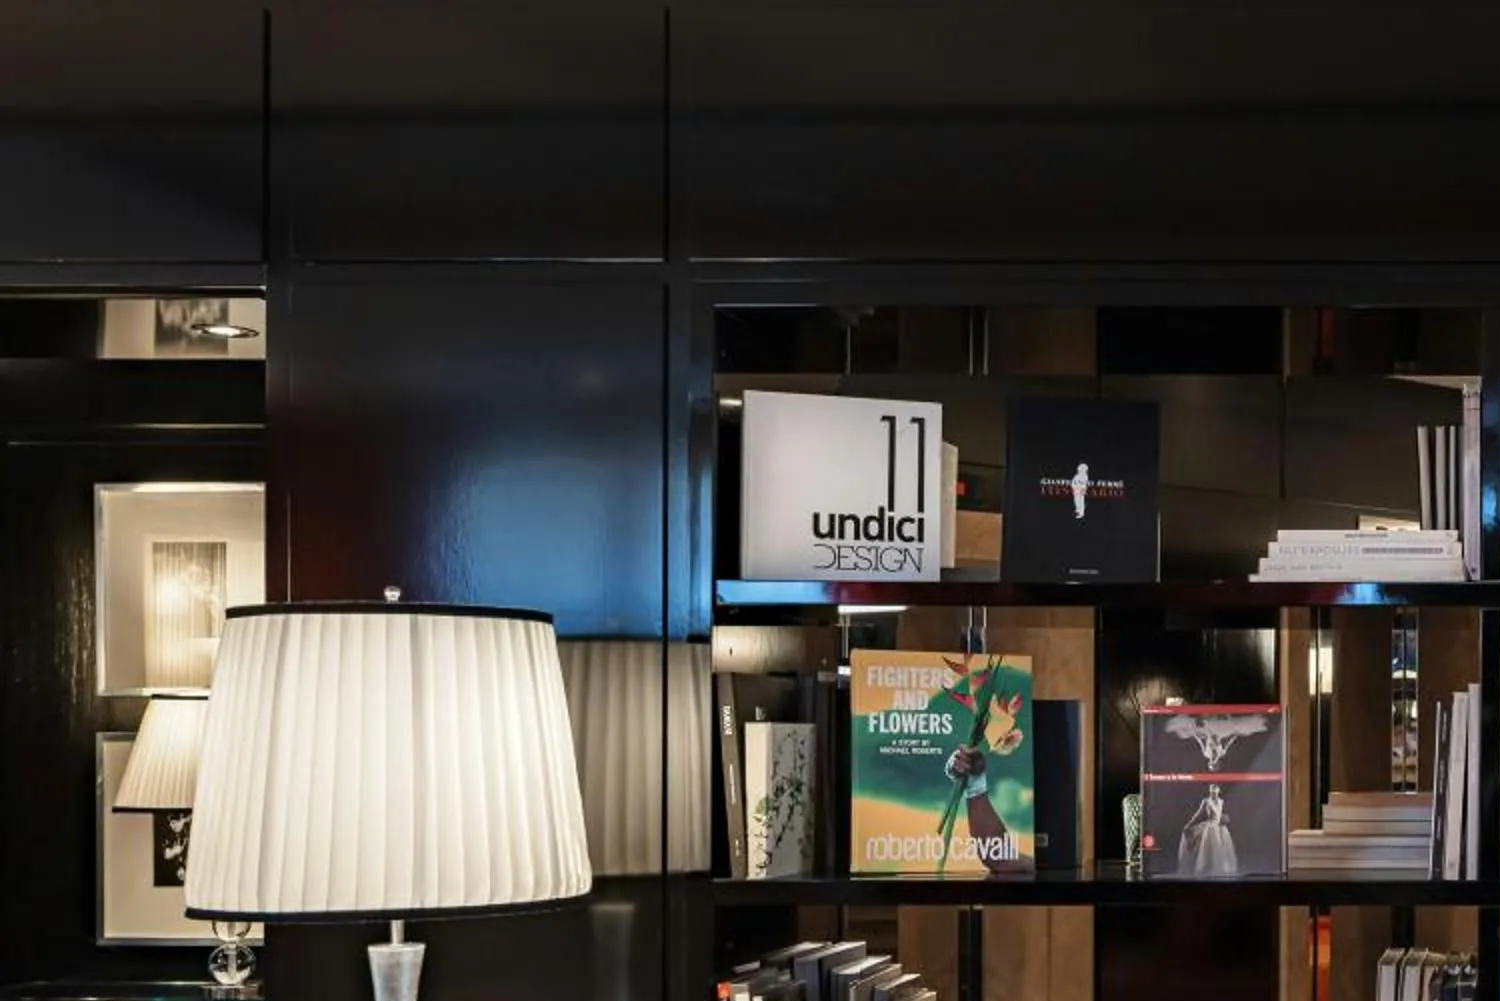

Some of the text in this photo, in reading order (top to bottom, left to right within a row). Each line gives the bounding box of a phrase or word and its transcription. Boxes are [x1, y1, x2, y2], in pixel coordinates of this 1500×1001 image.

[879, 415, 926, 512] 11
[812, 507, 926, 542] undici
[813, 543, 925, 575] DESIGN
[867, 665, 954, 688] FIGHTERS
[892, 690, 929, 711] AND
[868, 713, 954, 735] FLOWERS
[866, 832, 1019, 861] roberto cavalli
